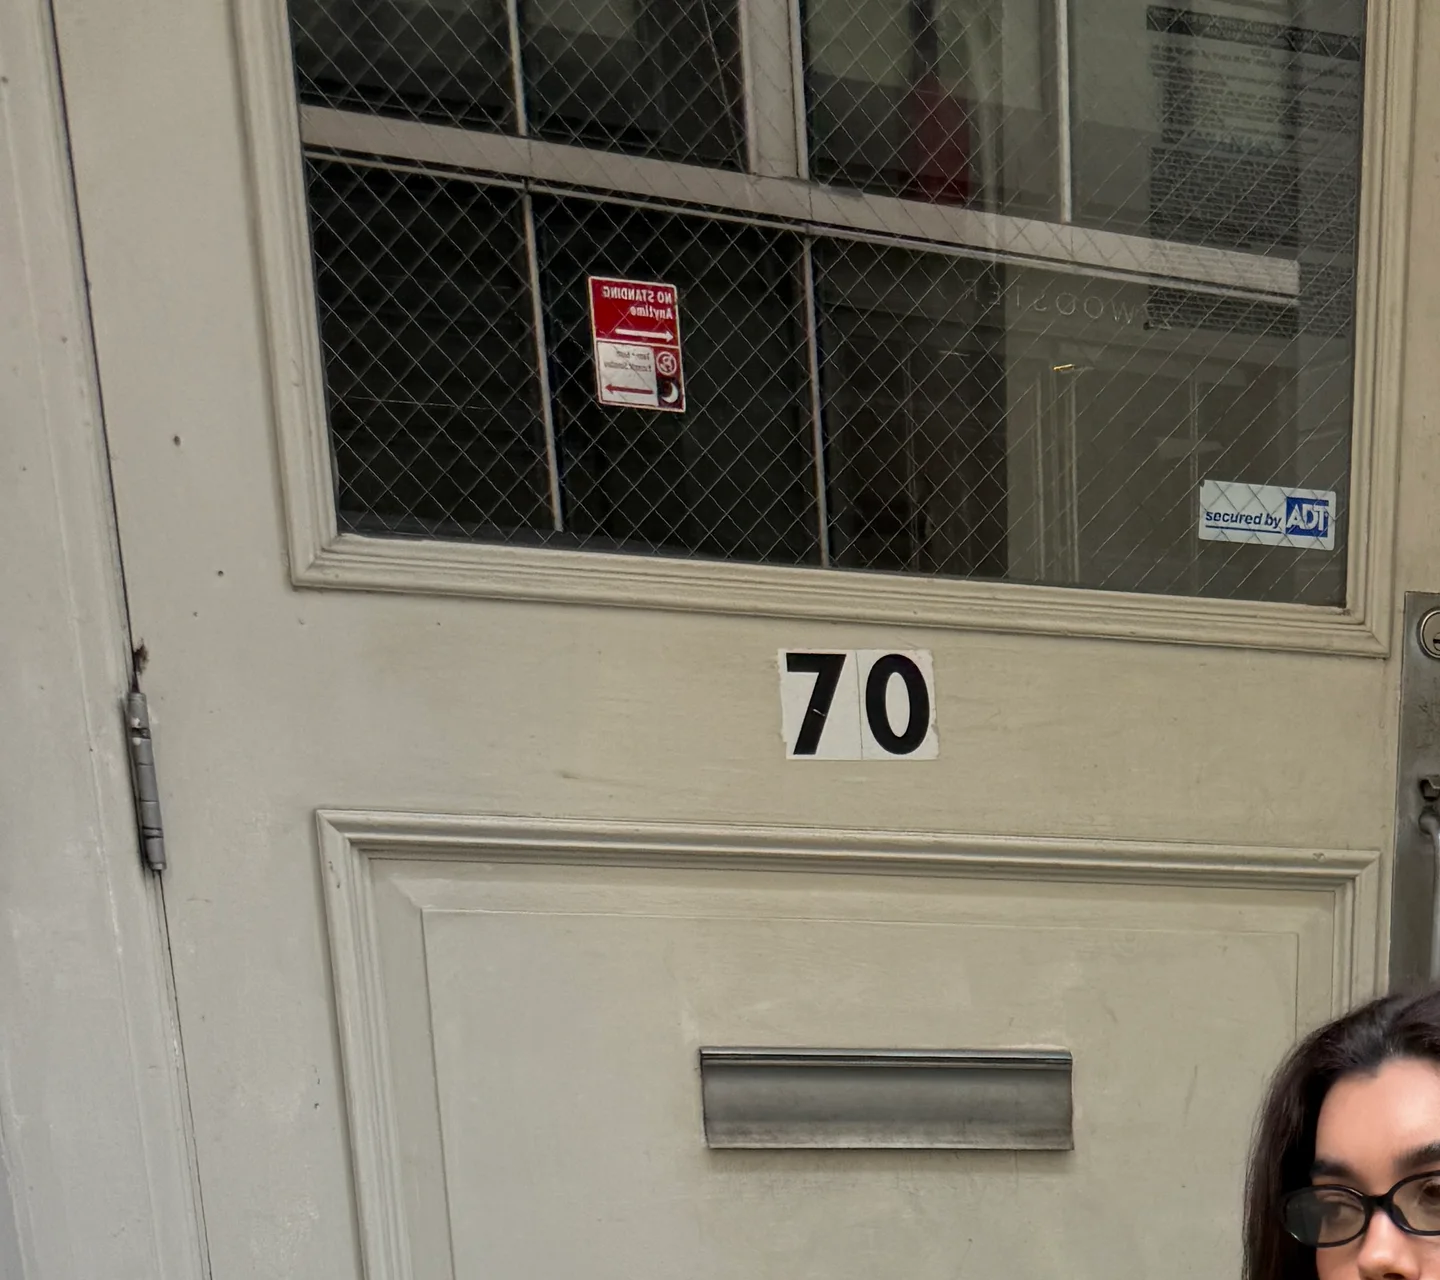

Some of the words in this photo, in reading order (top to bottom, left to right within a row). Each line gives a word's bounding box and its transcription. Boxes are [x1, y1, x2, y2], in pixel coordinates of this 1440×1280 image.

[1205, 511, 1263, 526] secured
[1264, 513, 1282, 529] by
[1286, 503, 1328, 532] ADT
[786, 652, 930, 755] 70
